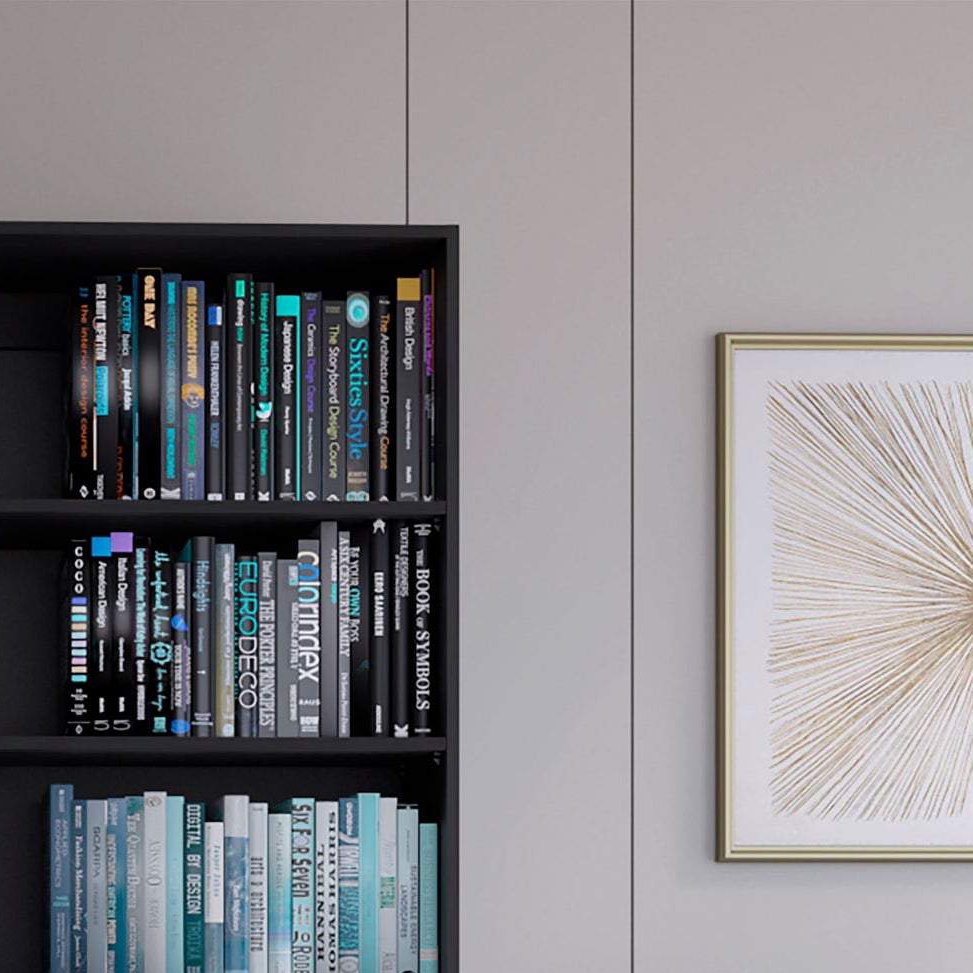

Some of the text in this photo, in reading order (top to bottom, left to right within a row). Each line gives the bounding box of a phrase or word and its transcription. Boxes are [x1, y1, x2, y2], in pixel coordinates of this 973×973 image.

[79, 304, 89, 324] the
[122, 295, 132, 356] POTTERY basics
[144, 275, 156, 329] ONE DAY
[235, 299, 245, 326] drawing
[259, 293, 269, 321] History
[79, 328, 89, 371] interior
[95, 323, 106, 361] NEWTON
[259, 334, 269, 365] Modern
[281, 321, 293, 394] Japanese Design
[306, 308, 316, 413] The Ceramics Design Course
[403, 307, 416, 370] British Design
[79, 375, 89, 414] design
[210, 340, 219, 416] HELEN FRANKENTHALER
[259, 368, 269, 396] Design
[350, 338, 369, 407] Sixties
[378, 314, 391, 470] The Architectural Drawing Course
[327, 325, 340, 478] The Storyboard Design Course
[79, 418, 89, 458] course
[260, 429, 268, 447] David
[346, 408, 369, 461] Style
[115, 558, 129, 612] Italian Design
[193, 560, 210, 612] Hindsights
[262, 560, 273, 598] David Porter
[329, 566, 338, 582] Space
[399, 527, 409, 597] TEXTILE DESIGNERS
[96, 561, 107, 629] American Design
[339, 537, 350, 657] A SIX CENTURY FAMILY
[349, 546, 361, 642] BE YOUR OWN BOSS
[373, 572, 384, 637] EERO SAARINEN
[173, 644, 183, 663] YOUR
[416, 550, 430, 710] THE BOOK OF SYMBOLS
[259, 600, 275, 726] THE PORTER PRINCIPLES
[173, 691, 183, 708] NOW
[93, 826, 101, 878] SCARPA
[187, 804, 201, 848] DIGITAL
[72, 836, 84, 930] Fashion Merchandising
[187, 854, 201, 868] BY
[251, 857, 266, 876] arts
[187, 874, 201, 915] DESIGN
[317, 844, 325, 960] HANNIBAL
